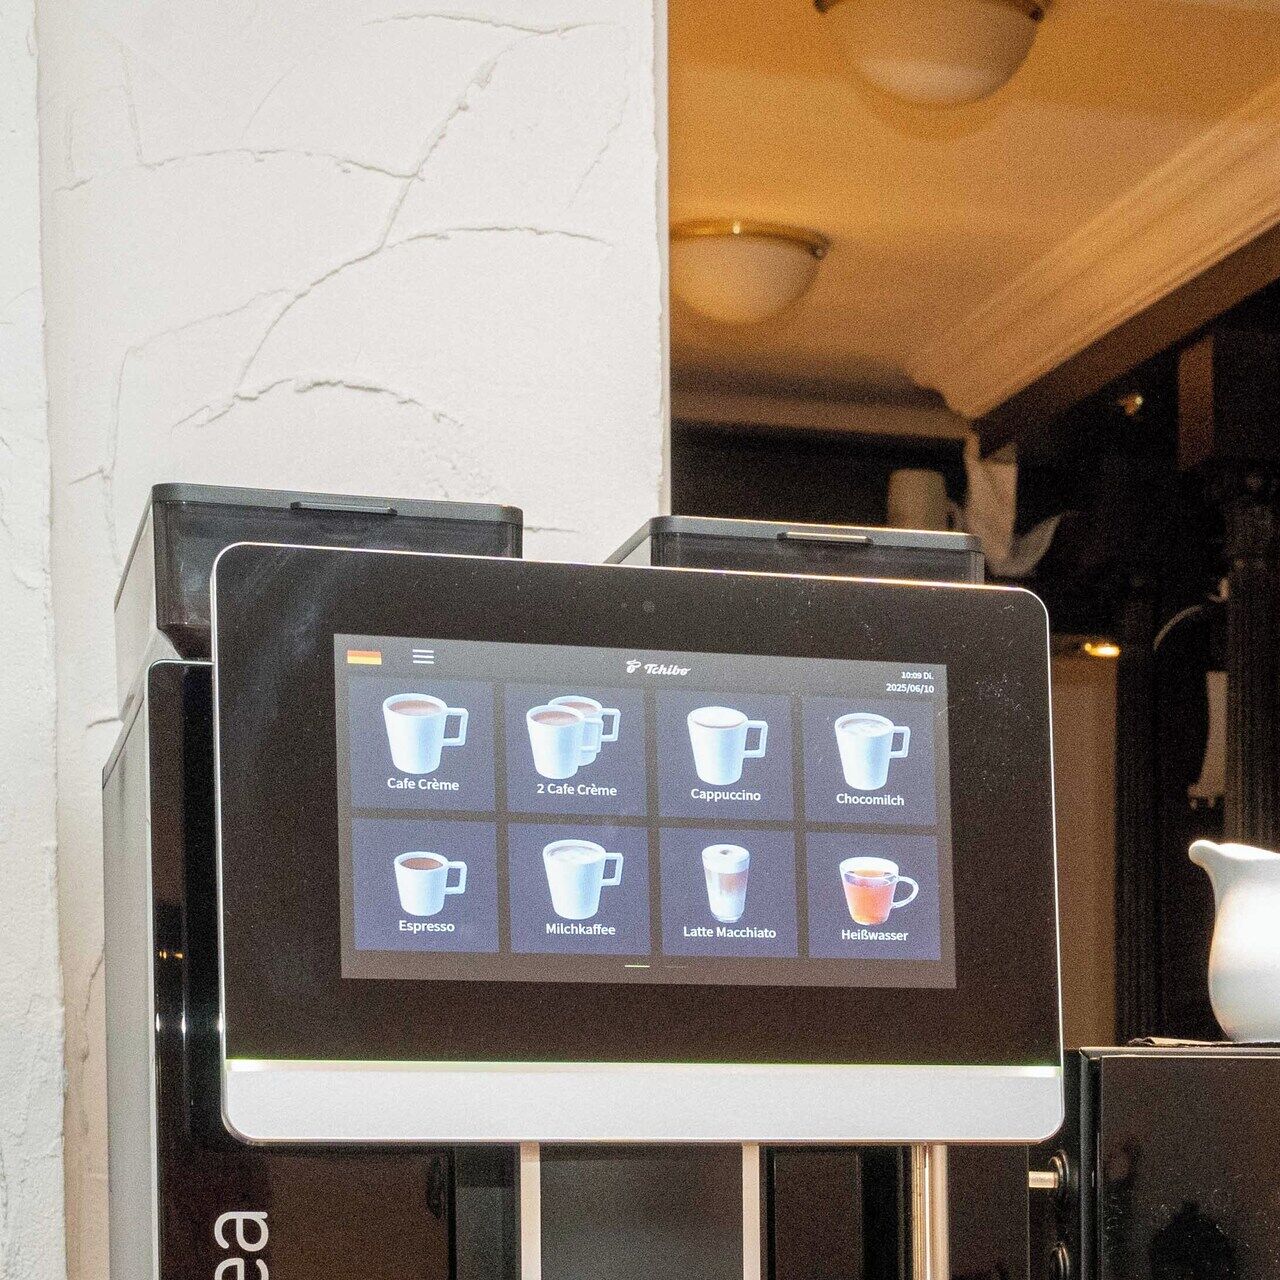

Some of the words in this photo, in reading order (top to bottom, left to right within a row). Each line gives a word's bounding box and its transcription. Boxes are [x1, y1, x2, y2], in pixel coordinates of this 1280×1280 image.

[644, 663, 691, 676] Tchibo
[901, 670, 922, 680] 10:09
[923, 670, 934, 680] Di.
[886, 682, 935, 694] 2025/06/10
[387, 777, 416, 790] Cafe
[418, 778, 459, 791] Crème
[536, 783, 545, 795] 2
[547, 783, 574, 795] Cafe
[577, 784, 617, 796] Crème
[691, 788, 761, 803] Cappuccino
[836, 793, 905, 806] Chocomilch
[398, 920, 455, 934] Espresso
[546, 922, 616, 936] Milchkaffee
[683, 926, 714, 938] Latte
[716, 927, 777, 939] Macchiato
[841, 929, 909, 942] Heißwasser
